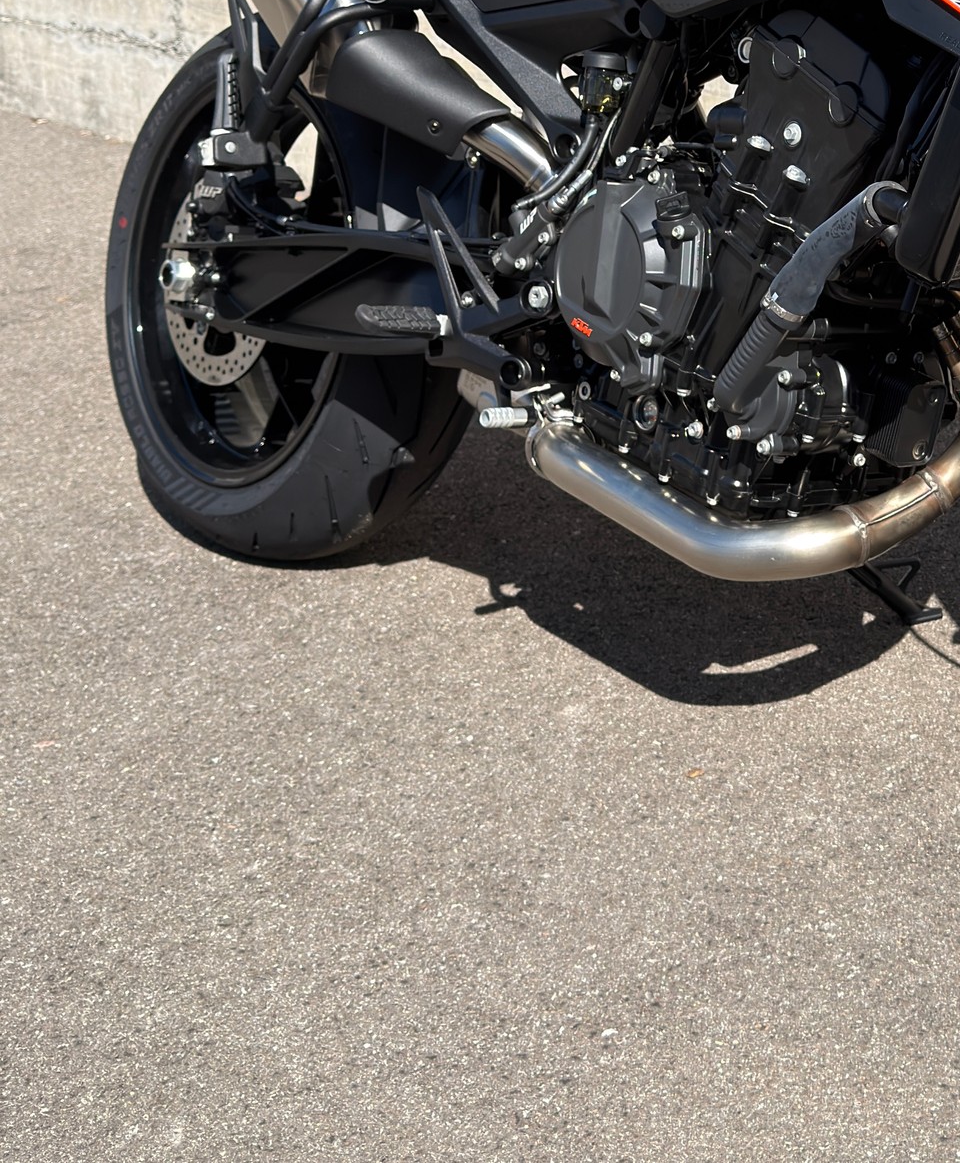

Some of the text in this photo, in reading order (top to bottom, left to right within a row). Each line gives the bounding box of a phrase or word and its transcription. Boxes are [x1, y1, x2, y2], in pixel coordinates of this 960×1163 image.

[200, 185, 224, 199] WP
[519, 206, 538, 235] WP
[570, 317, 593, 338] KTM
